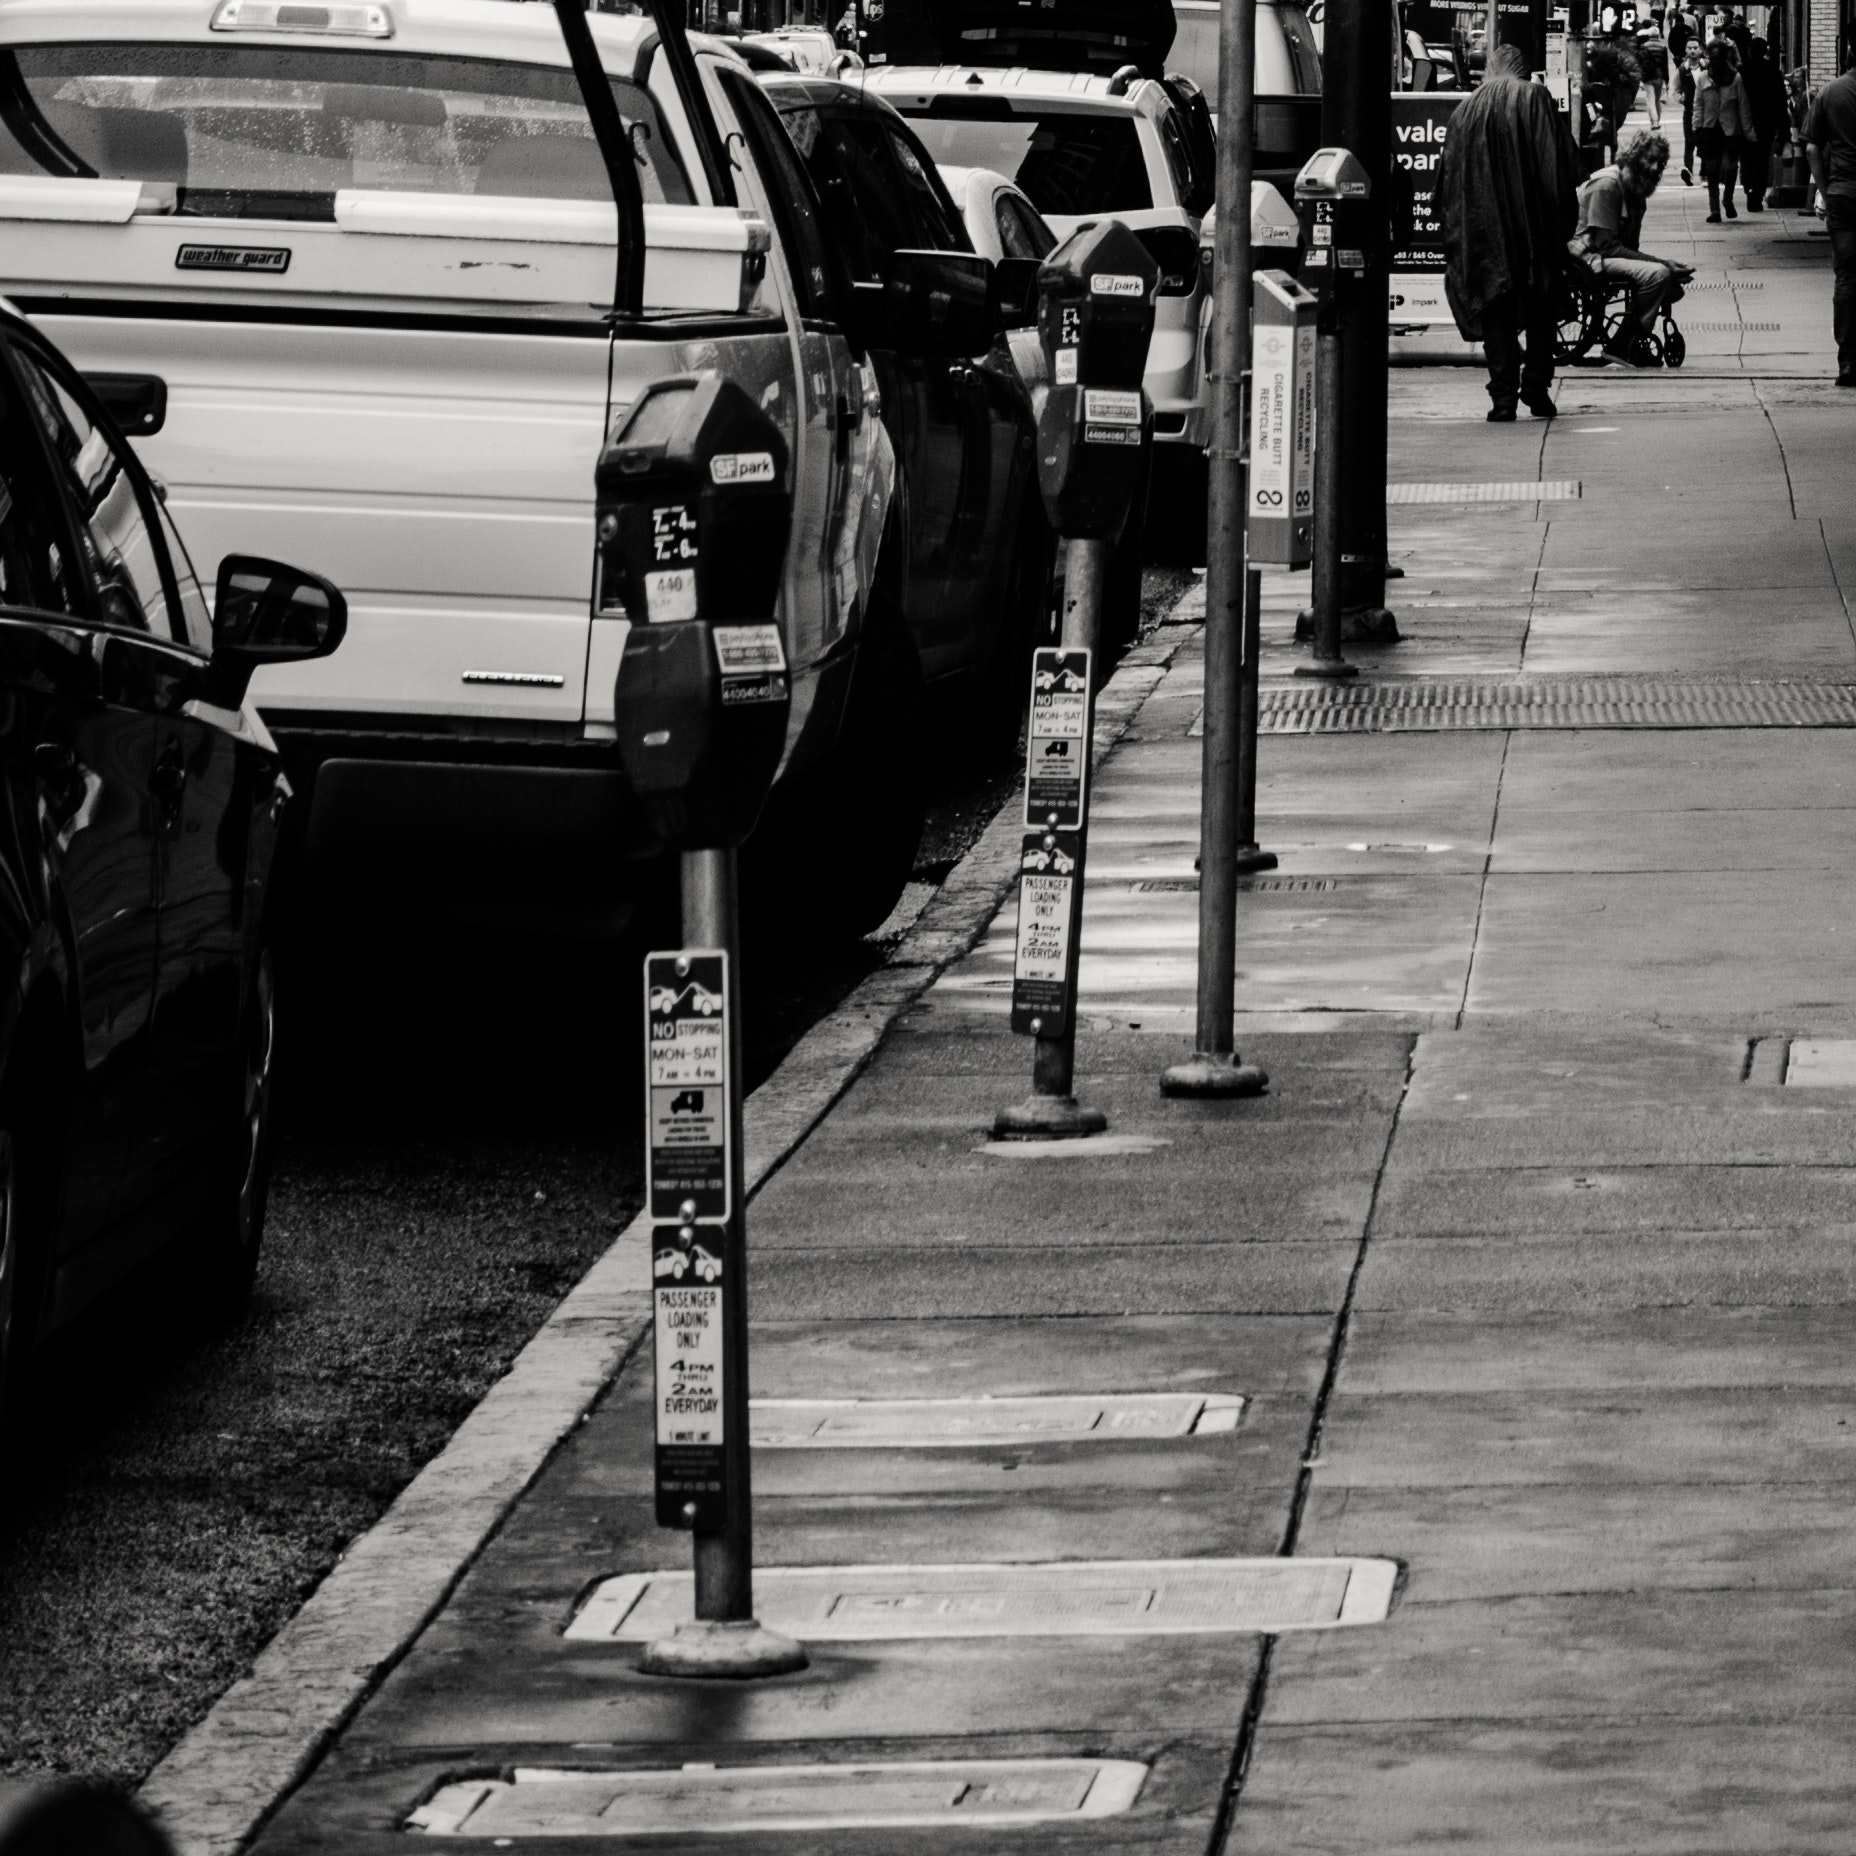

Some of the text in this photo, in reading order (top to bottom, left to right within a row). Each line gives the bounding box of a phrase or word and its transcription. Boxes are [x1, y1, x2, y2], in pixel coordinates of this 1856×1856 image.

[182, 248, 284, 267] weather guard
[1036, 695, 1051, 707] NO
[1025, 877, 1068, 891] PASSENGER
[1030, 892, 1062, 904] LOADING
[1035, 906, 1054, 917] ONLY
[1022, 948, 1062, 960] EVERYDAY
[653, 1021, 721, 1039] NO STOPPING
[652, 1046, 718, 1061] MON-SAT
[660, 1291, 717, 1308] PASSENGER
[668, 1312, 710, 1329] LOADING
[676, 1331, 701, 1349] ONLY
[665, 1398, 718, 1414] EVERYDAY
